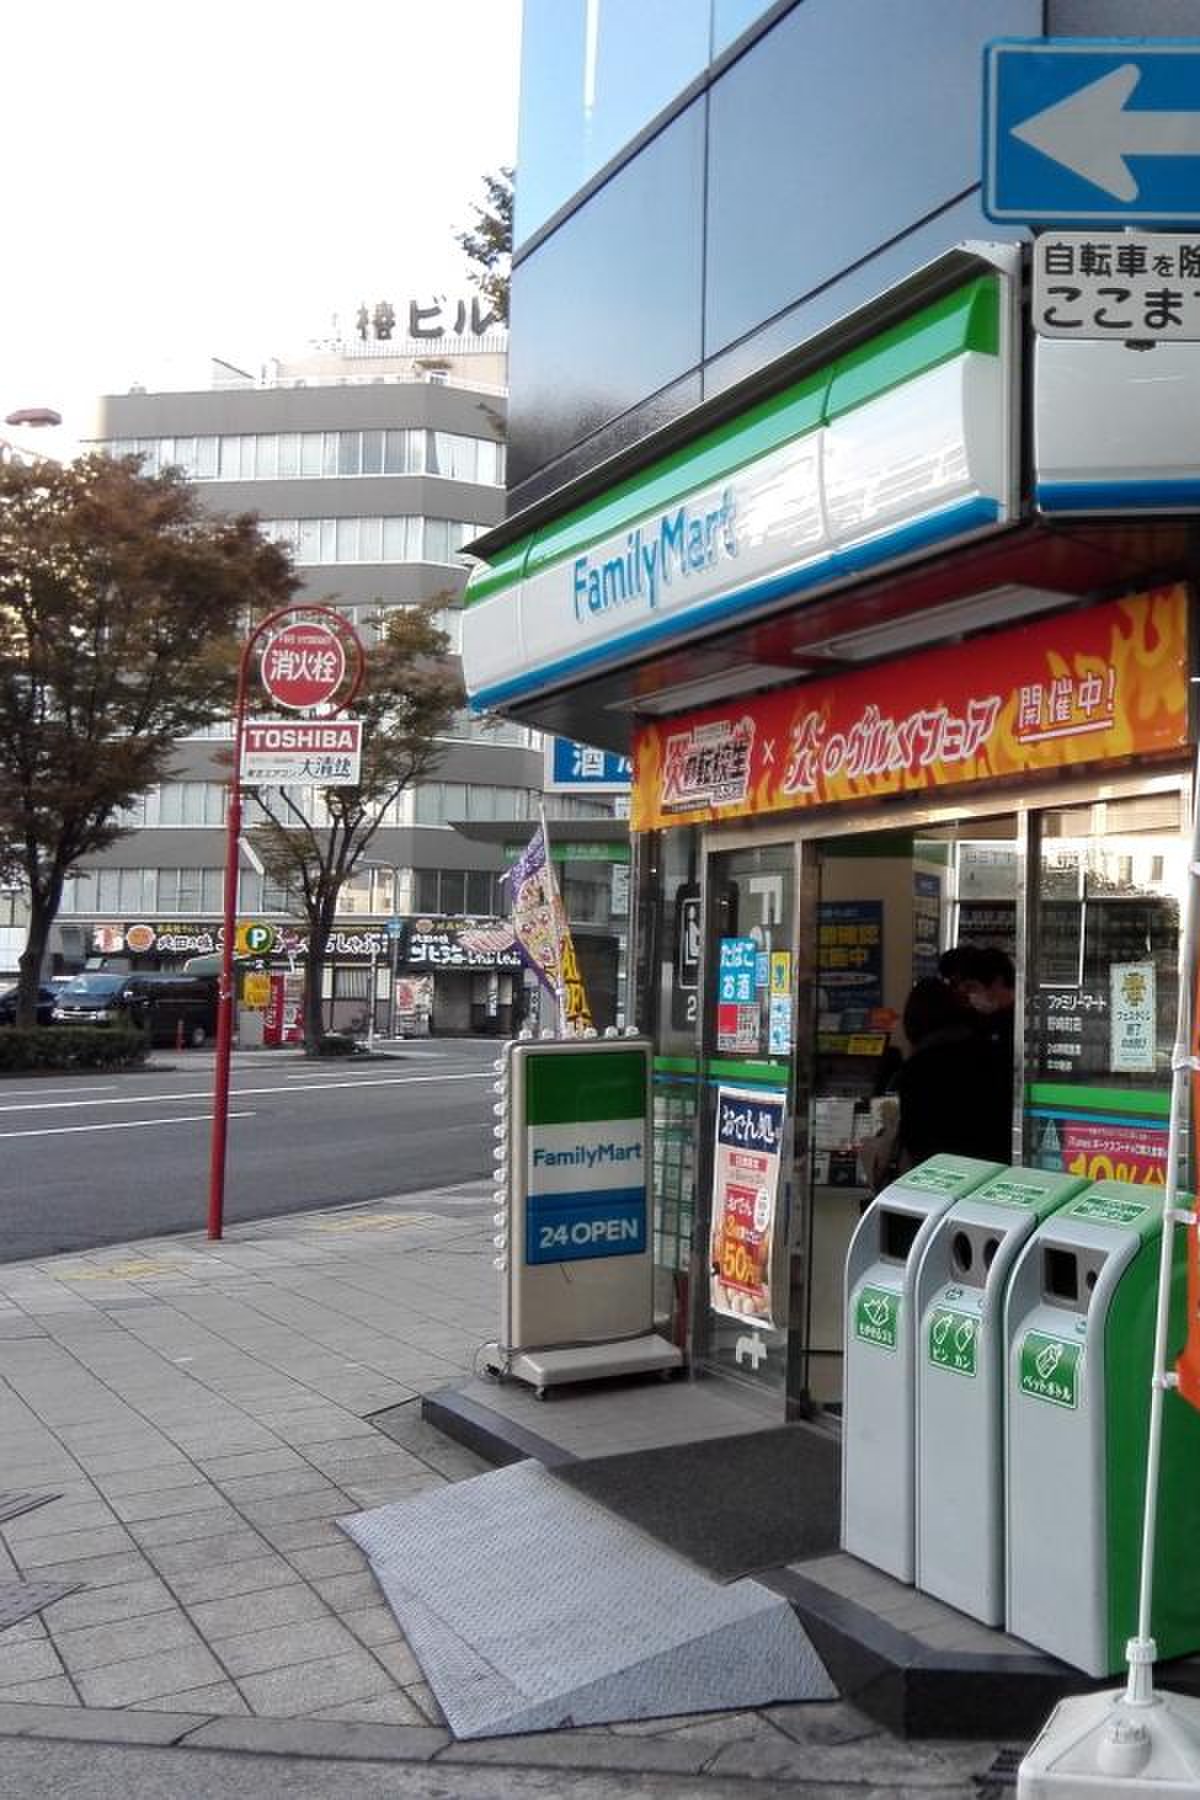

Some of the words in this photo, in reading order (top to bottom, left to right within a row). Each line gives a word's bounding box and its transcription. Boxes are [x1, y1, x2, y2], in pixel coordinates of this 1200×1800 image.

[574, 482, 738, 624] FamilyMart
[270, 649, 337, 683] 消火栓
[251, 729, 353, 749] TOSHIBA
[252, 927, 267, 949] P
[1047, 994, 1106, 1013] ファミリーマート
[533, 1142, 642, 1168] FamilyMart
